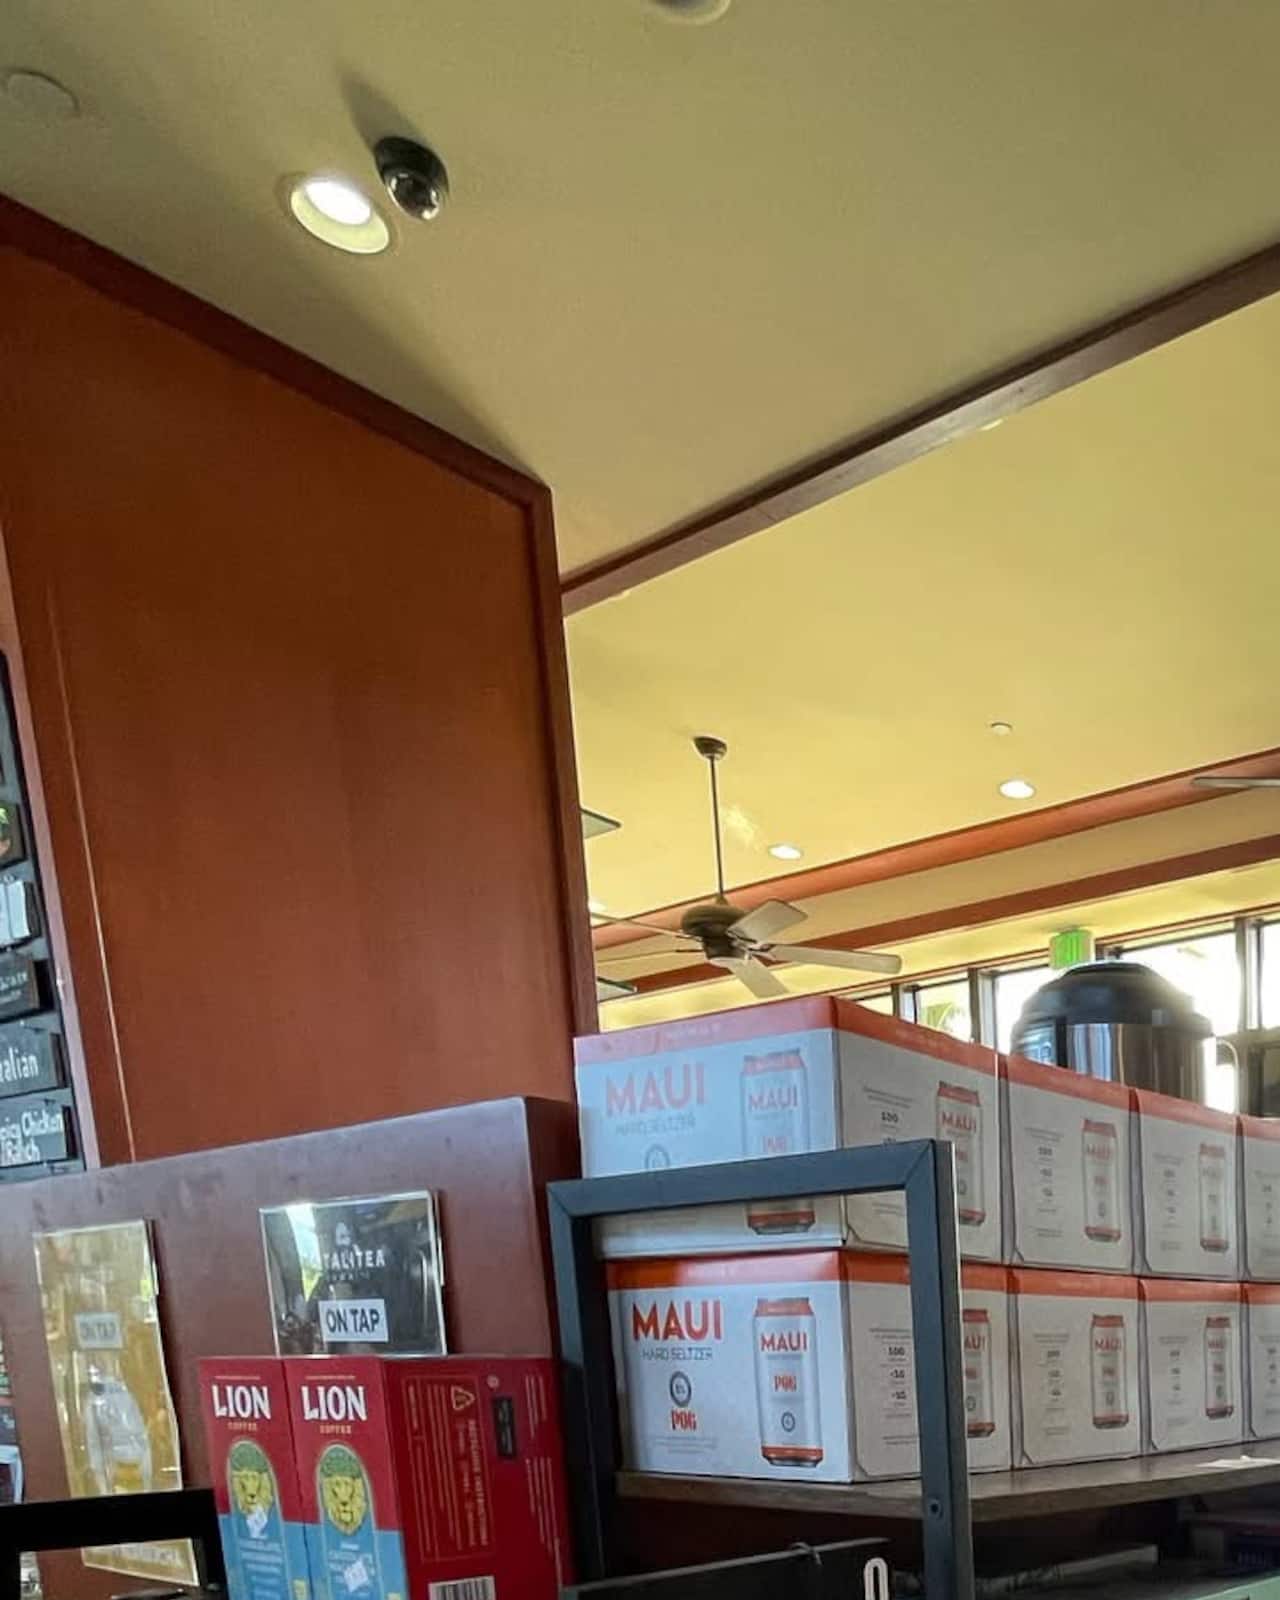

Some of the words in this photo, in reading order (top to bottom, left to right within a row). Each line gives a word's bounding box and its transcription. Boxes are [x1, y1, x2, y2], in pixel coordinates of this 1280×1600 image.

[606, 1062, 711, 1119] MAUI
[748, 1086, 799, 1111] MAUI
[325, 1312, 348, 1333] ON
[350, 1309, 381, 1332] TAP
[632, 1299, 724, 1343] MAUI
[760, 1332, 808, 1352] MAUI
[211, 1383, 271, 1421] LION
[301, 1384, 367, 1422] LION
